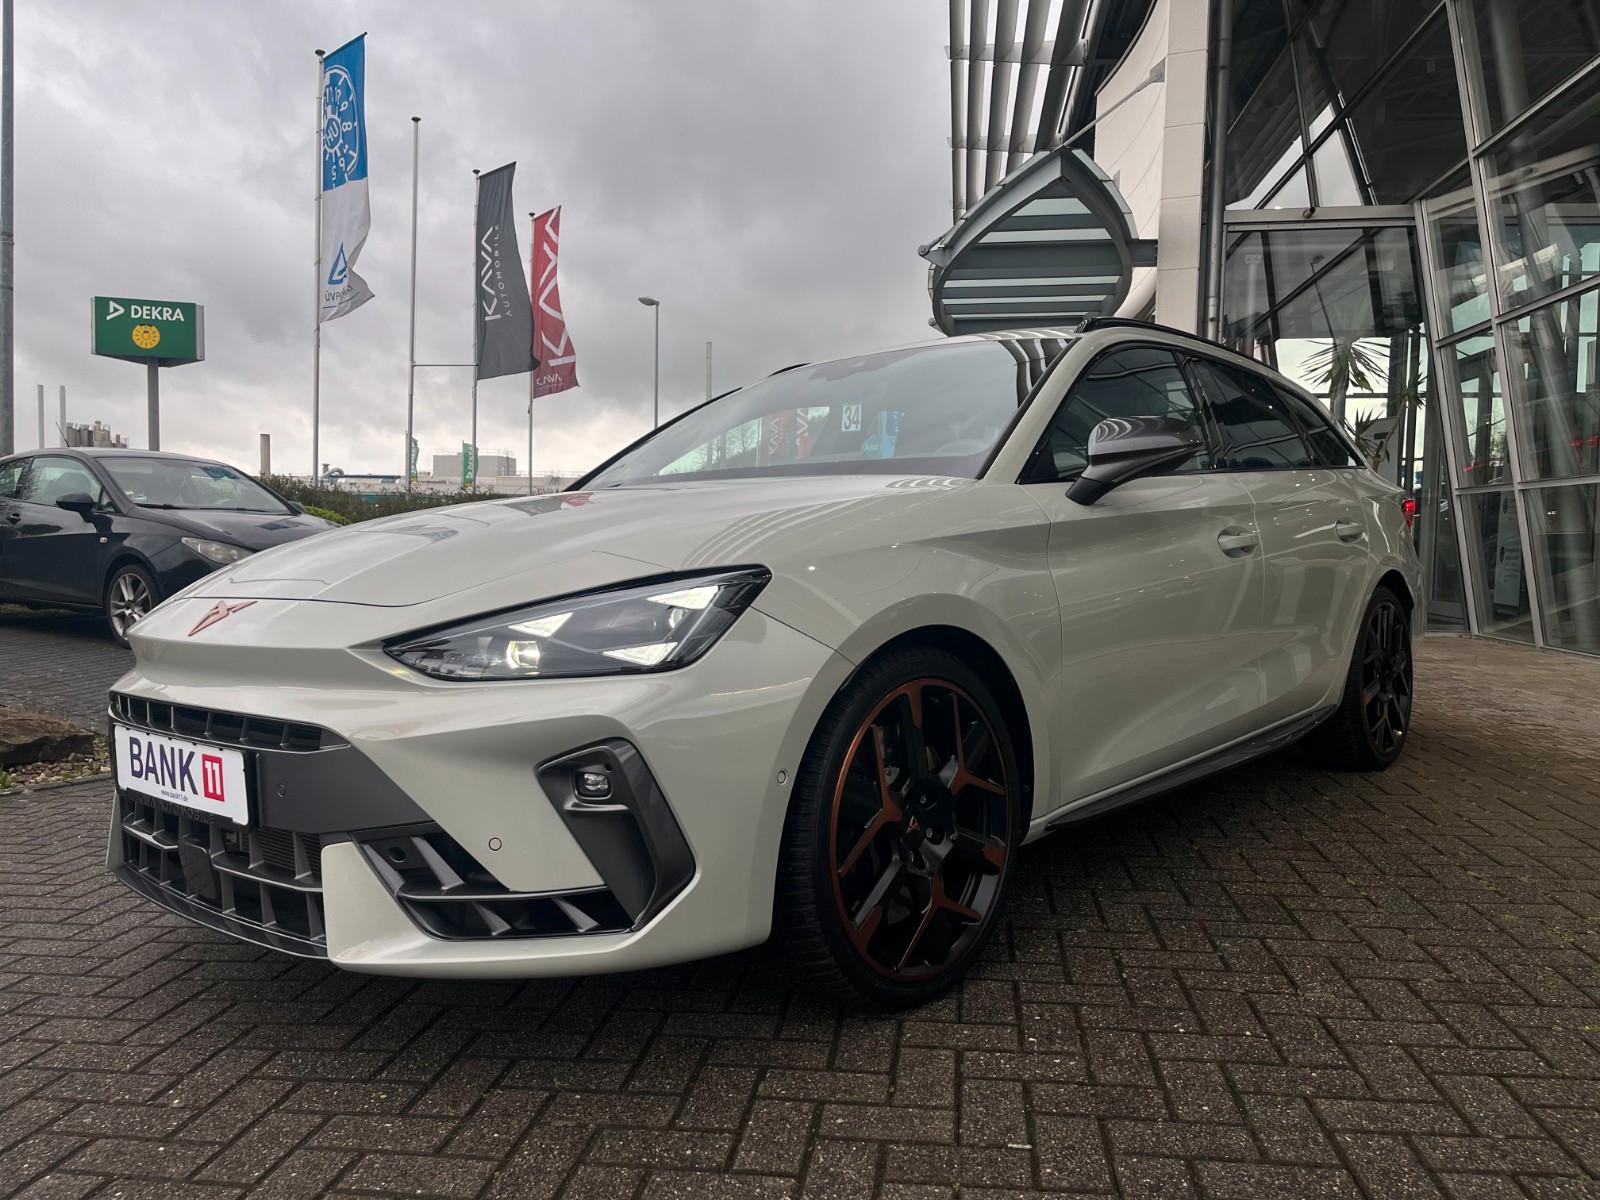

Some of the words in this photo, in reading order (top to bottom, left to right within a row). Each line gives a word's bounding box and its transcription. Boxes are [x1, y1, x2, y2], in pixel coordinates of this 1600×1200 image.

[325, 120, 339, 146] HU
[341, 121, 353, 132] 8
[481, 226, 502, 321] KAVA
[493, 224, 513, 318] AUTOMOBILE
[130, 304, 185, 322] DEKRA
[844, 405, 860, 430] 34
[129, 736, 198, 795] BANK
